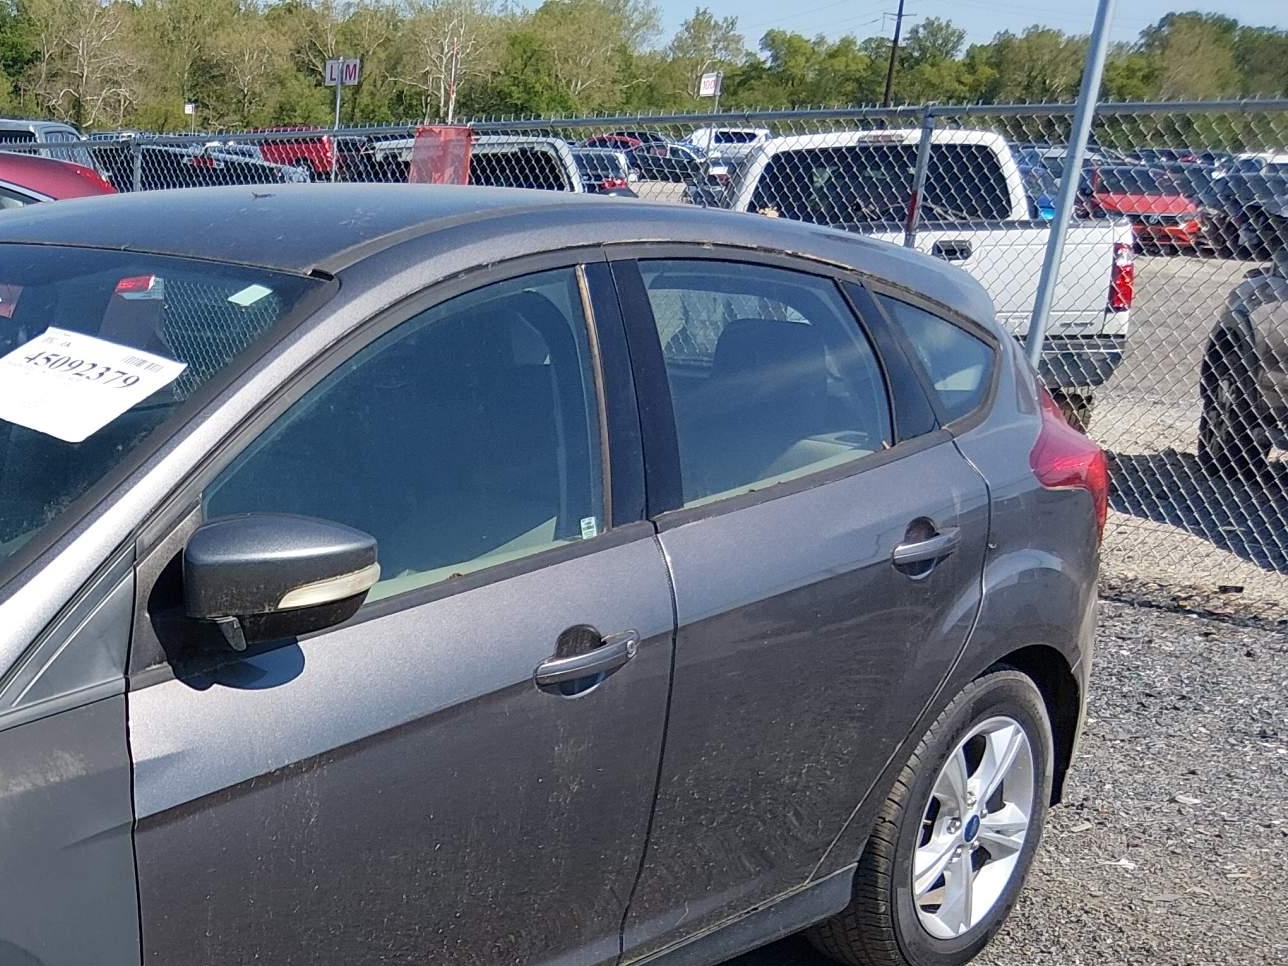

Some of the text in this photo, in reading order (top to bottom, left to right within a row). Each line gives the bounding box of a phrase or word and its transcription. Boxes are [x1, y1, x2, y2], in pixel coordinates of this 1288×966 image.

[329, 64, 357, 81] L M
[23, 351, 141, 389] 45092379
